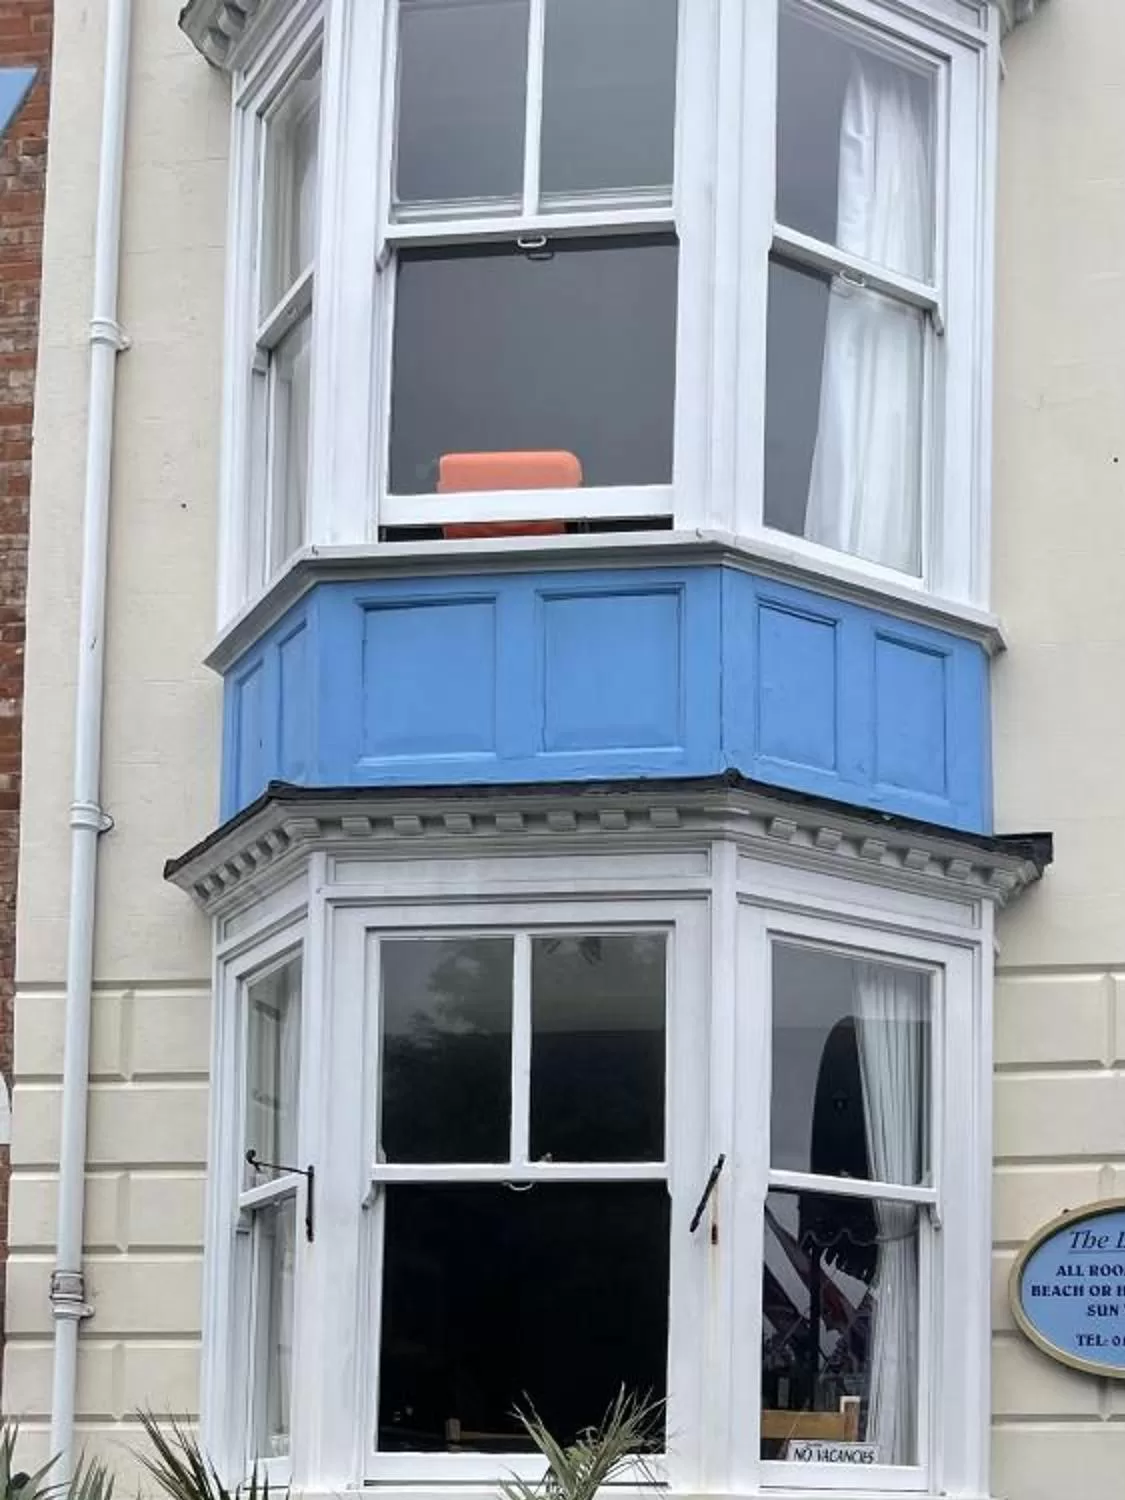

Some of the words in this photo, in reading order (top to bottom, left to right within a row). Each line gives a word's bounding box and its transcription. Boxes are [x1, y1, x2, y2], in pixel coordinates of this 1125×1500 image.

[1069, 1230, 1109, 1250] The
[1056, 1264, 1085, 1277] ALL
[1031, 1284, 1084, 1297] BEACH
[1089, 1284, 1112, 1297] OR
[1087, 1303, 1119, 1317] SUN
[794, 1447, 812, 1462] NO
